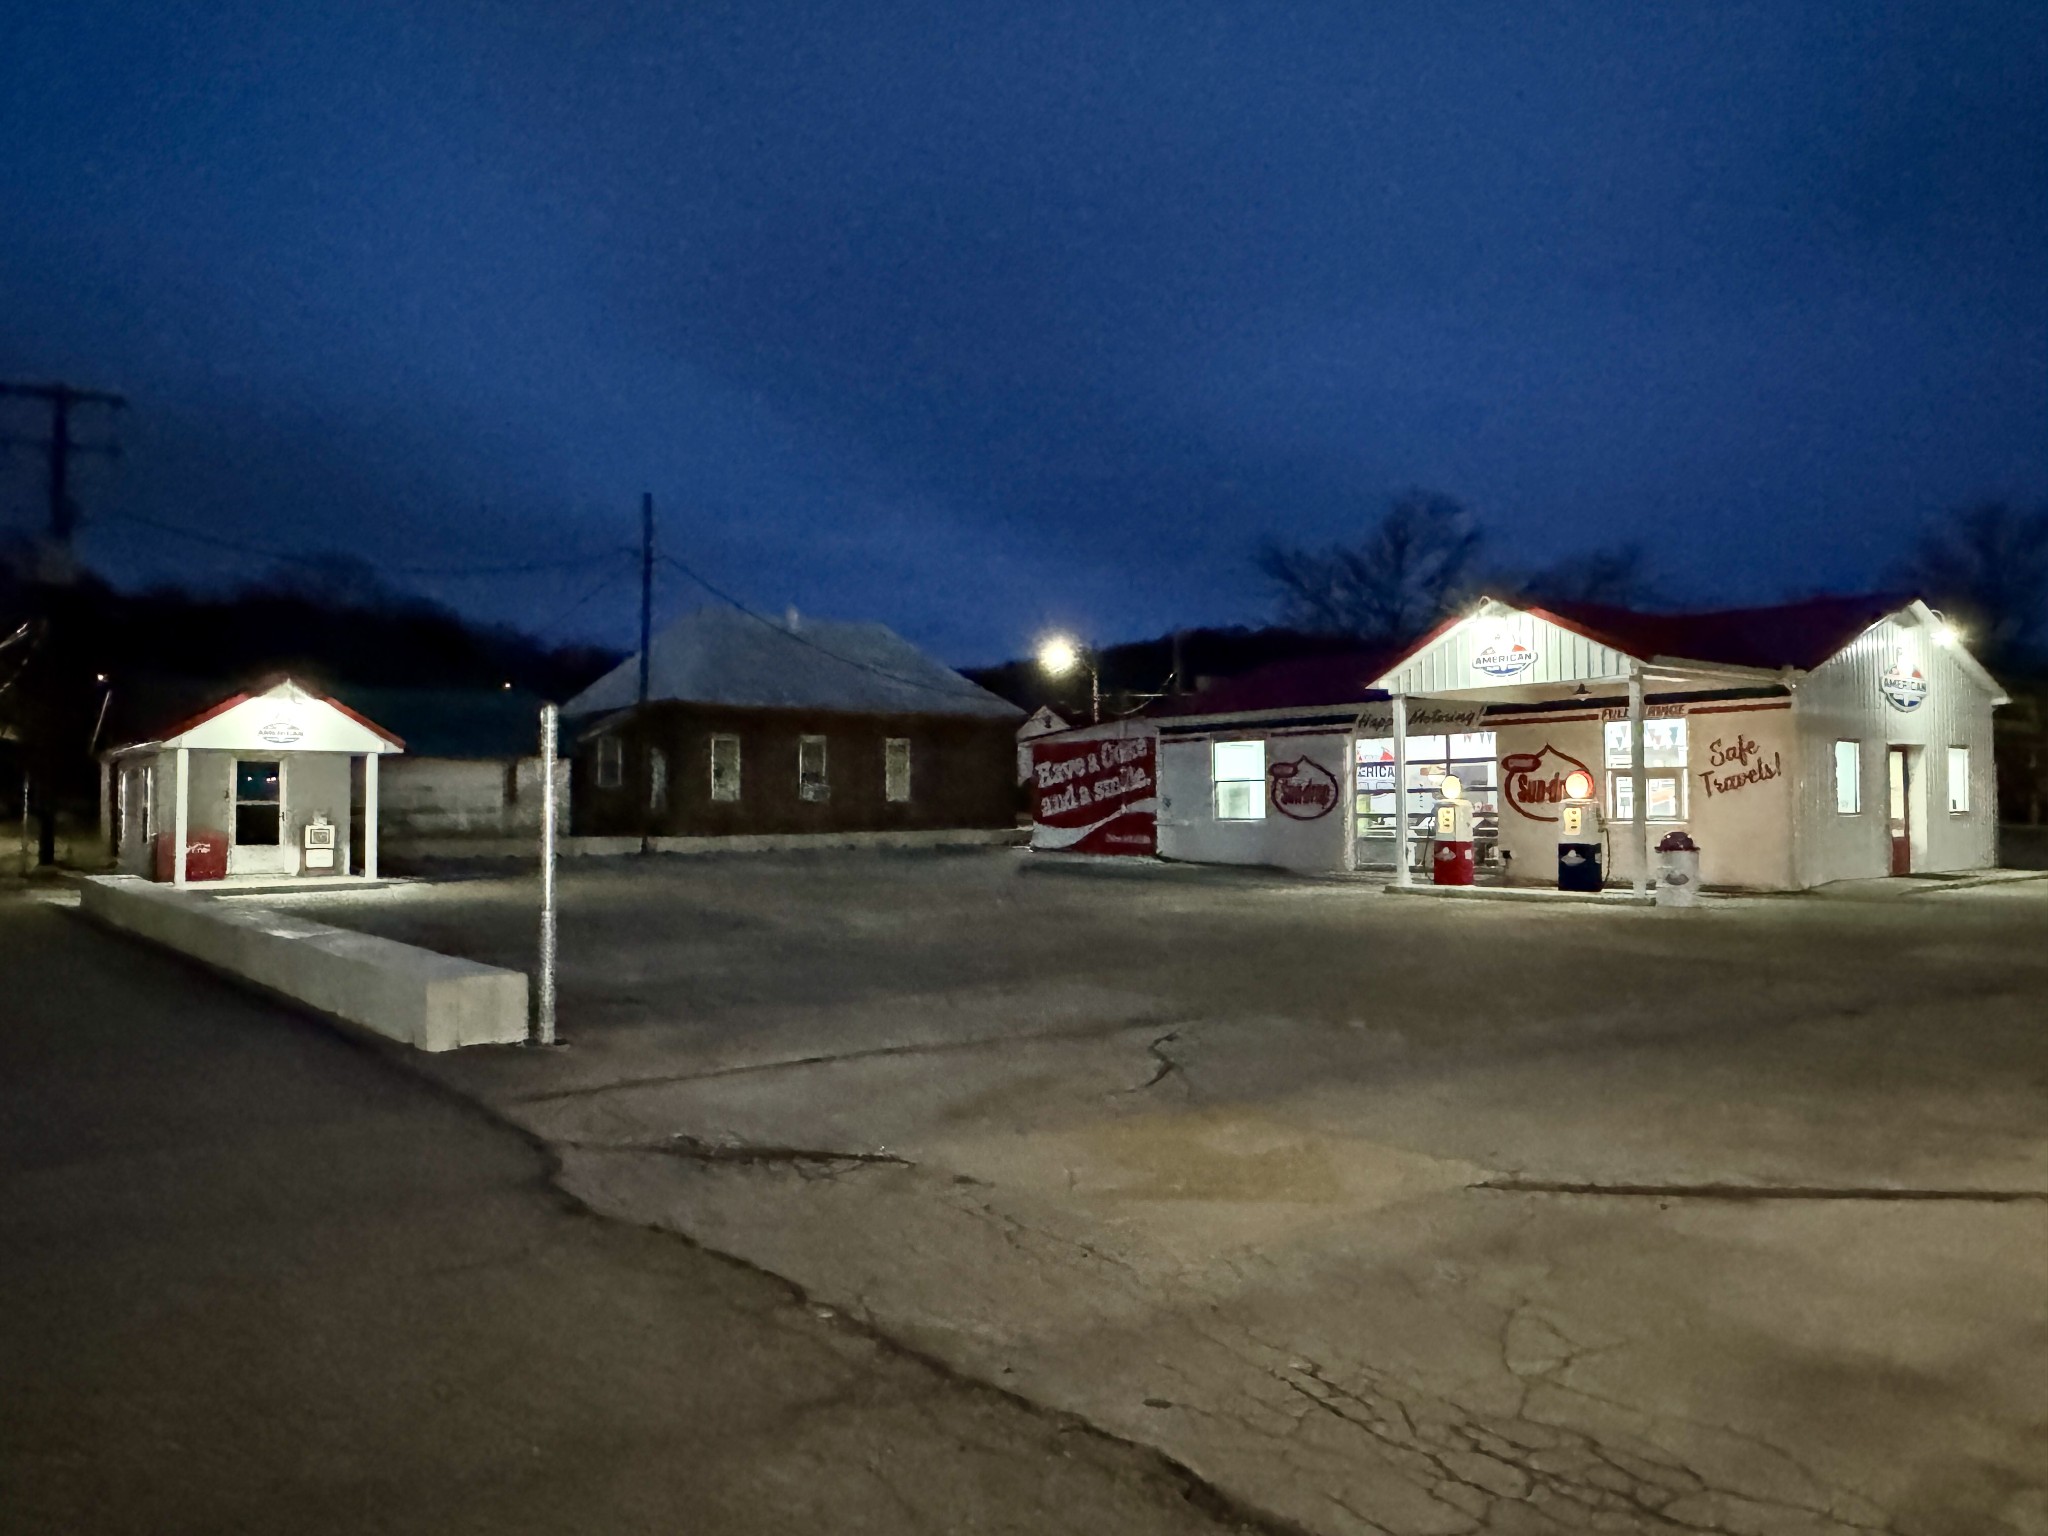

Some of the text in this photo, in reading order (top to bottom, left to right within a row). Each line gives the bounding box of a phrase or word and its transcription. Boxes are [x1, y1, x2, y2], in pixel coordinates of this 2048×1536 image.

[1475, 652, 1532, 665] AMERICAN
[1884, 677, 1927, 693] AMERICAN
[1358, 706, 1485, 732] Happ Motoring!
[1709, 734, 1761, 767] Safe
[1358, 766, 1395, 778] ERICA
[1698, 752, 1782, 798] Travels!
